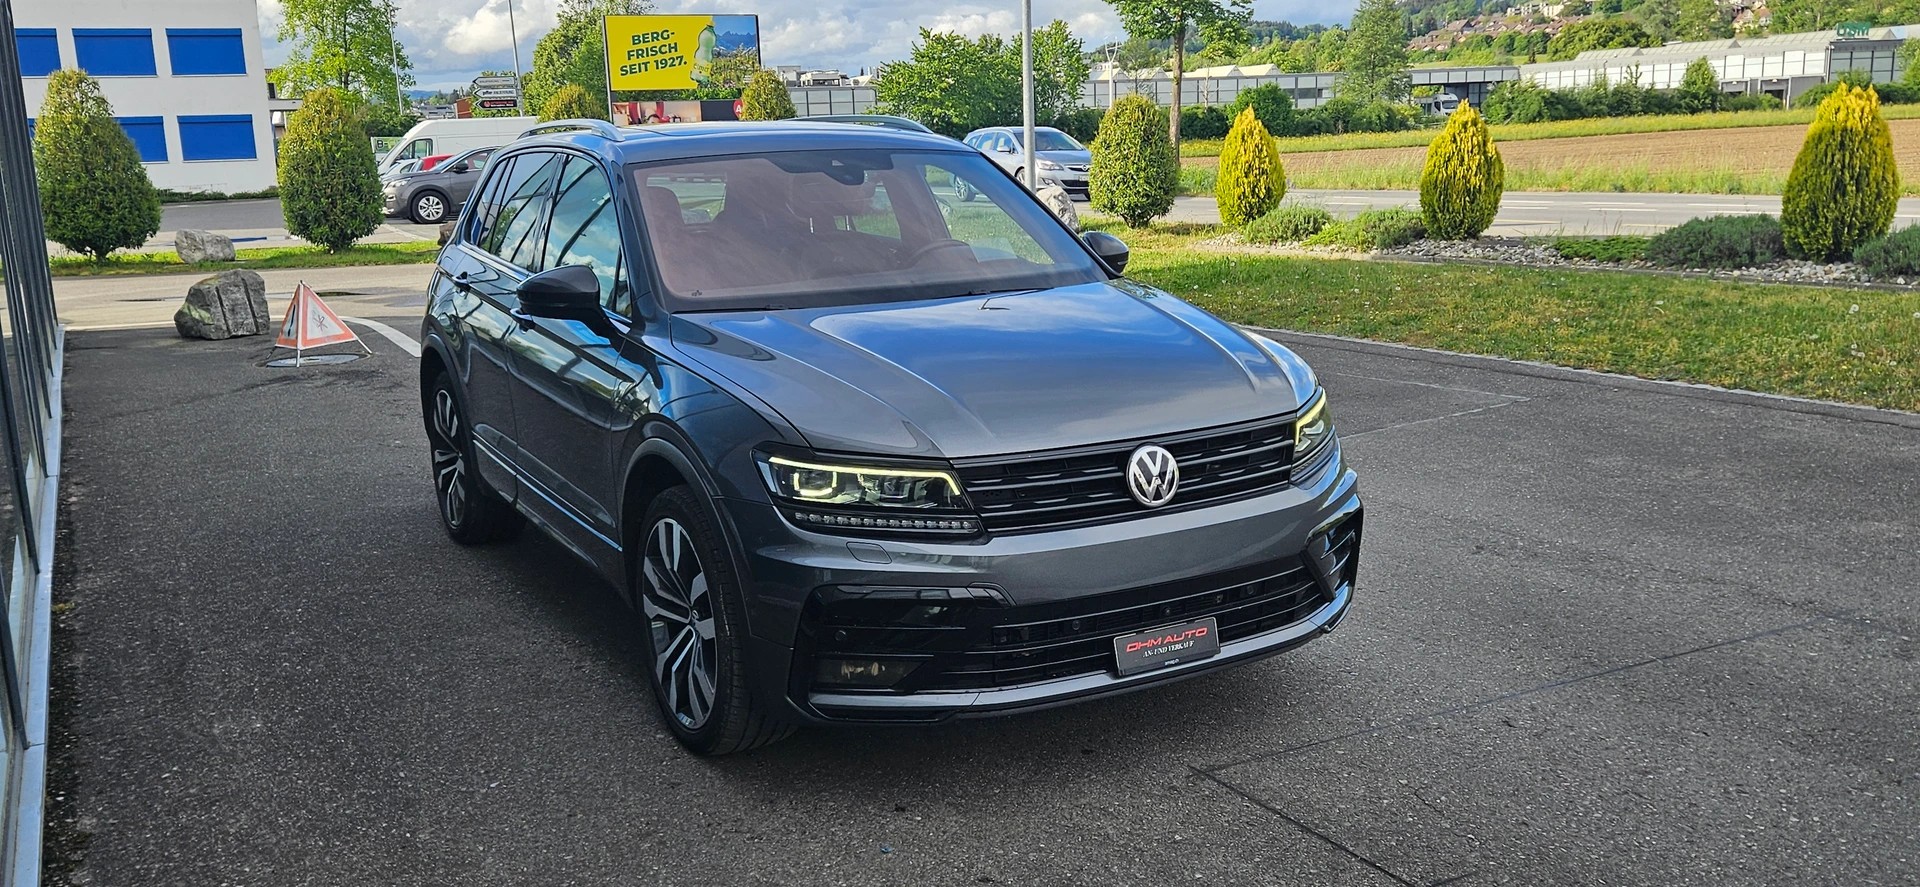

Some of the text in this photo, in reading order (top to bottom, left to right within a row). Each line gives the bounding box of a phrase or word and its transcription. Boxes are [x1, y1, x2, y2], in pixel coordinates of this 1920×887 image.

[631, 29, 675, 46] BERG-
[627, 42, 678, 60] FRISCH
[620, 61, 650, 76] SEIT
[654, 55, 688, 70] 1927.
[1128, 446, 1178, 505] VW
[1163, 627, 1208, 644] AUTO
